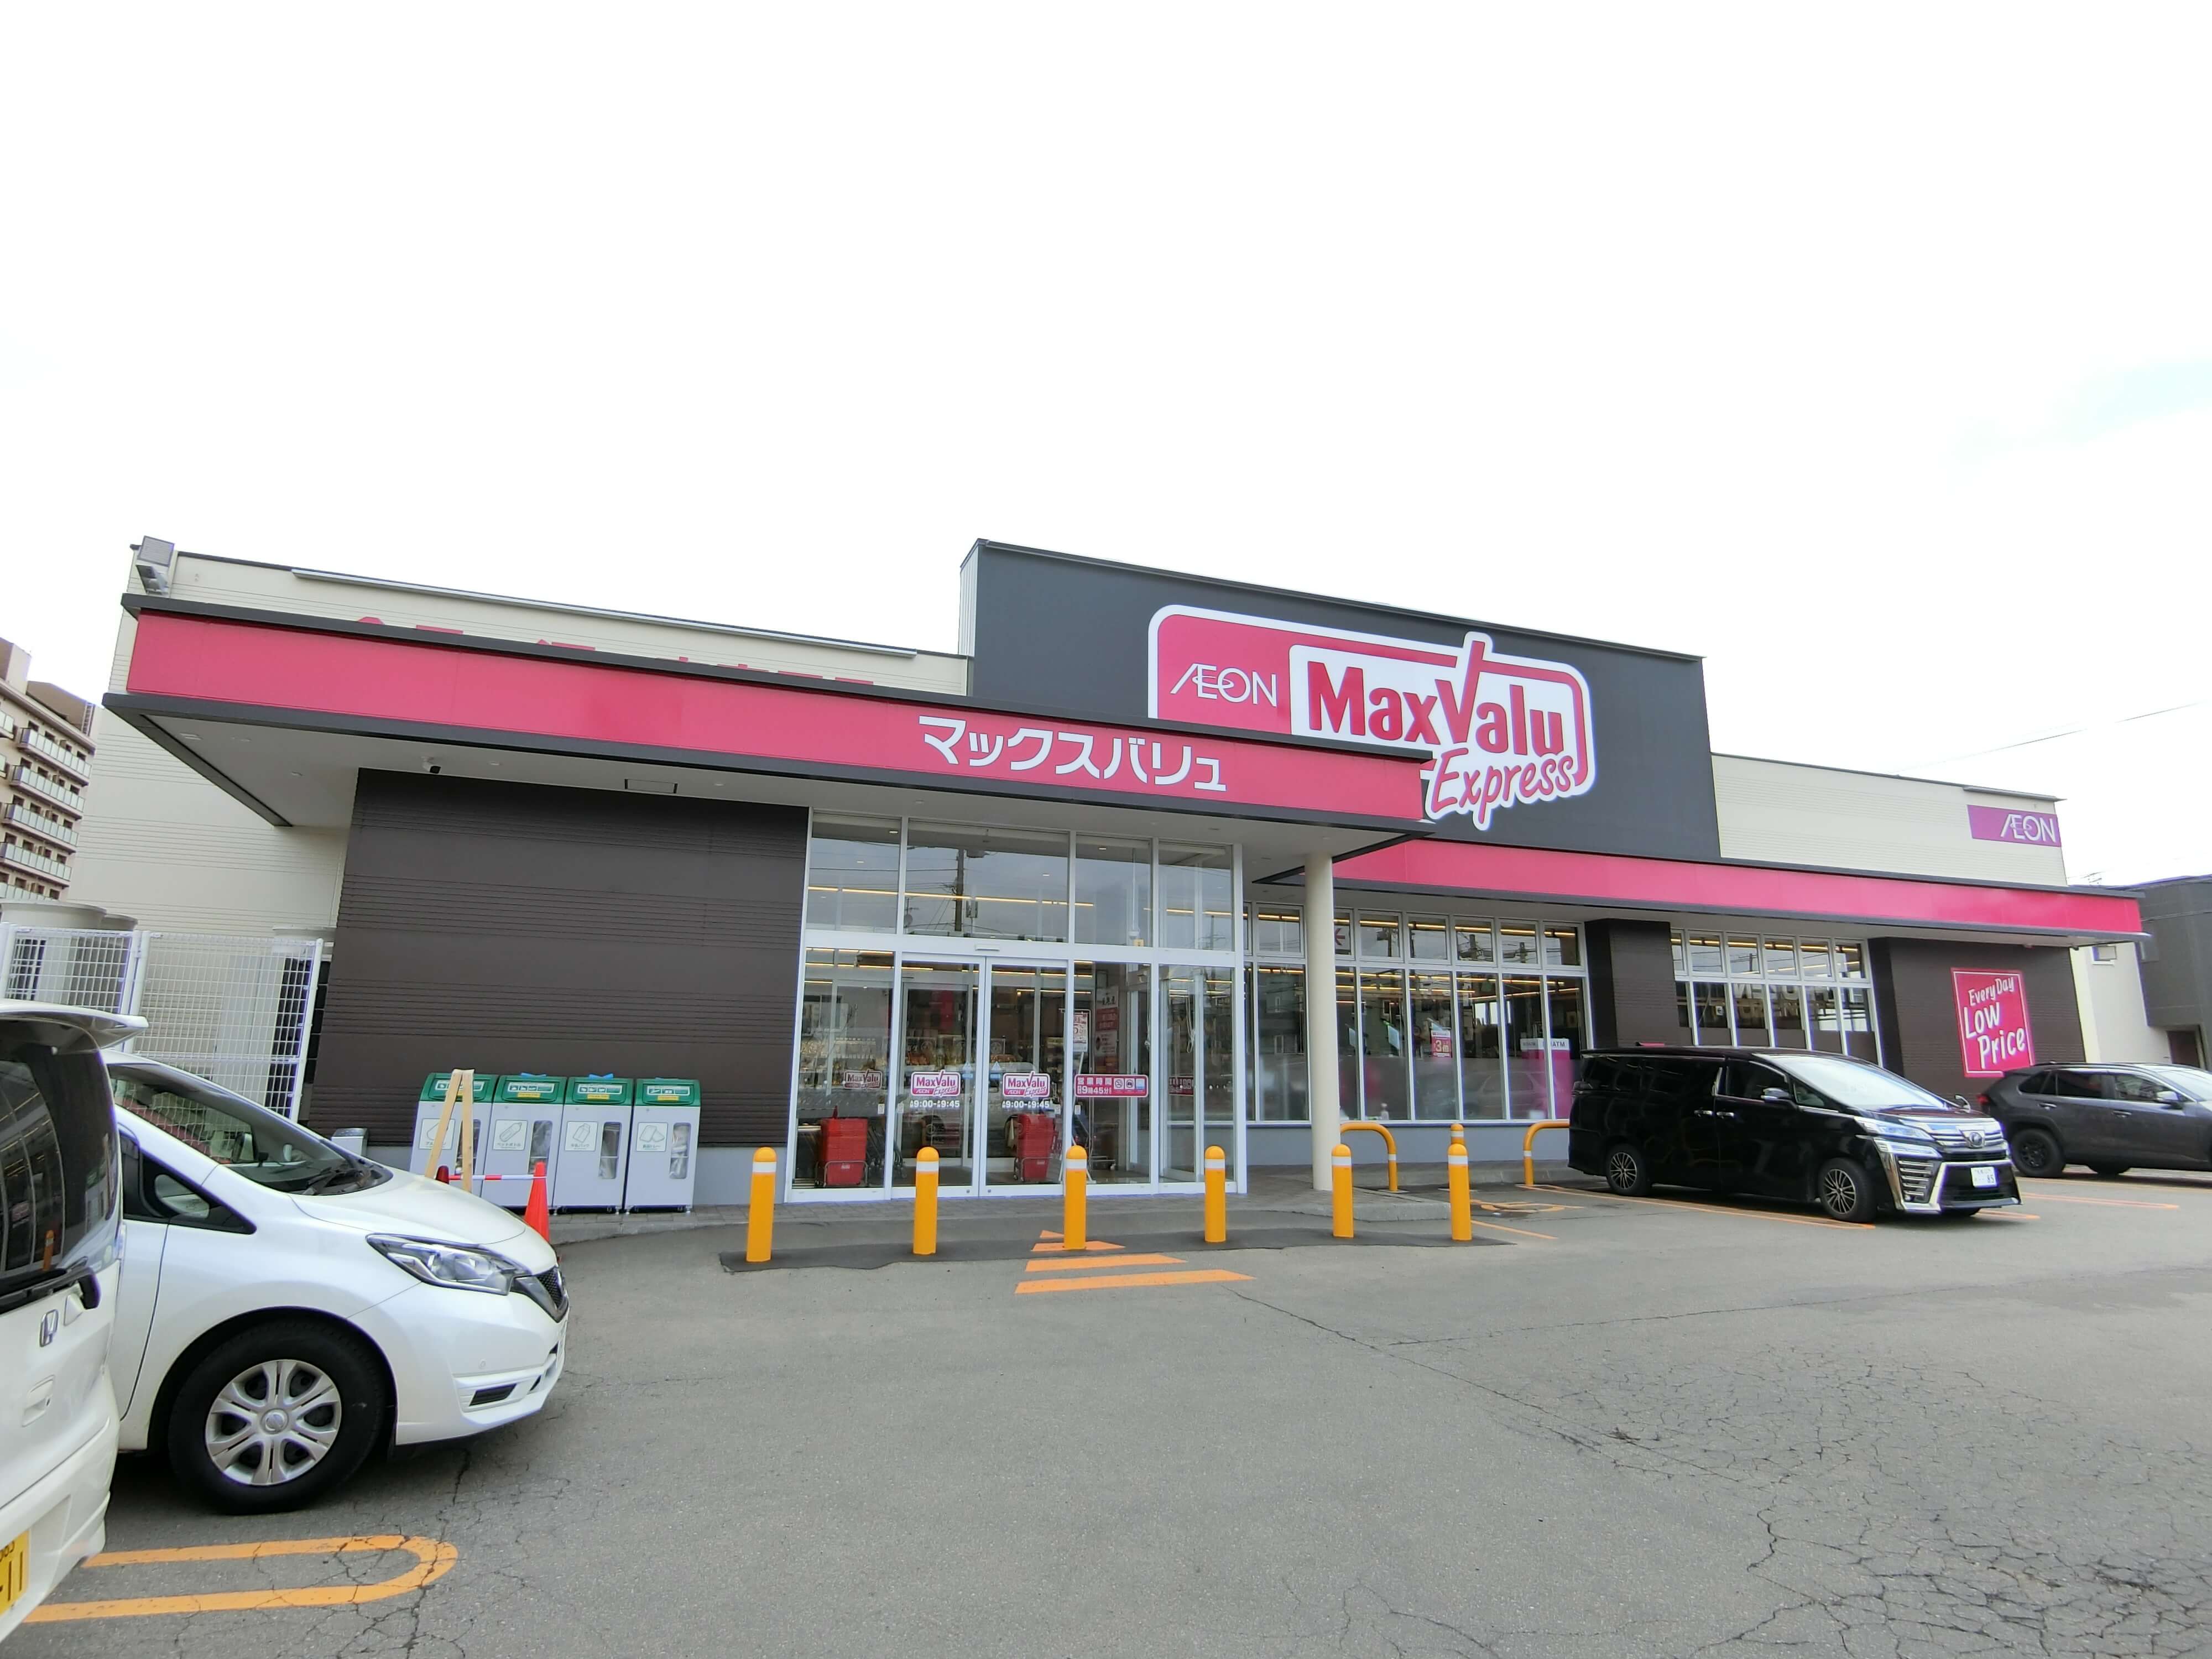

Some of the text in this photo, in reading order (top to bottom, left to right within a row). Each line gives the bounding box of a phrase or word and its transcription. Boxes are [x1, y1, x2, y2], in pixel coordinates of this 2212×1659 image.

[1307, 640, 1564, 758] MaxValu
[918, 714, 1227, 792] マックスバリュ
[1431, 747, 1574, 825] Express
[1977, 1027, 2026, 1070] Price
[916, 1071, 956, 1087] MaxValu
[1008, 1072, 1045, 1088] MaxValu
